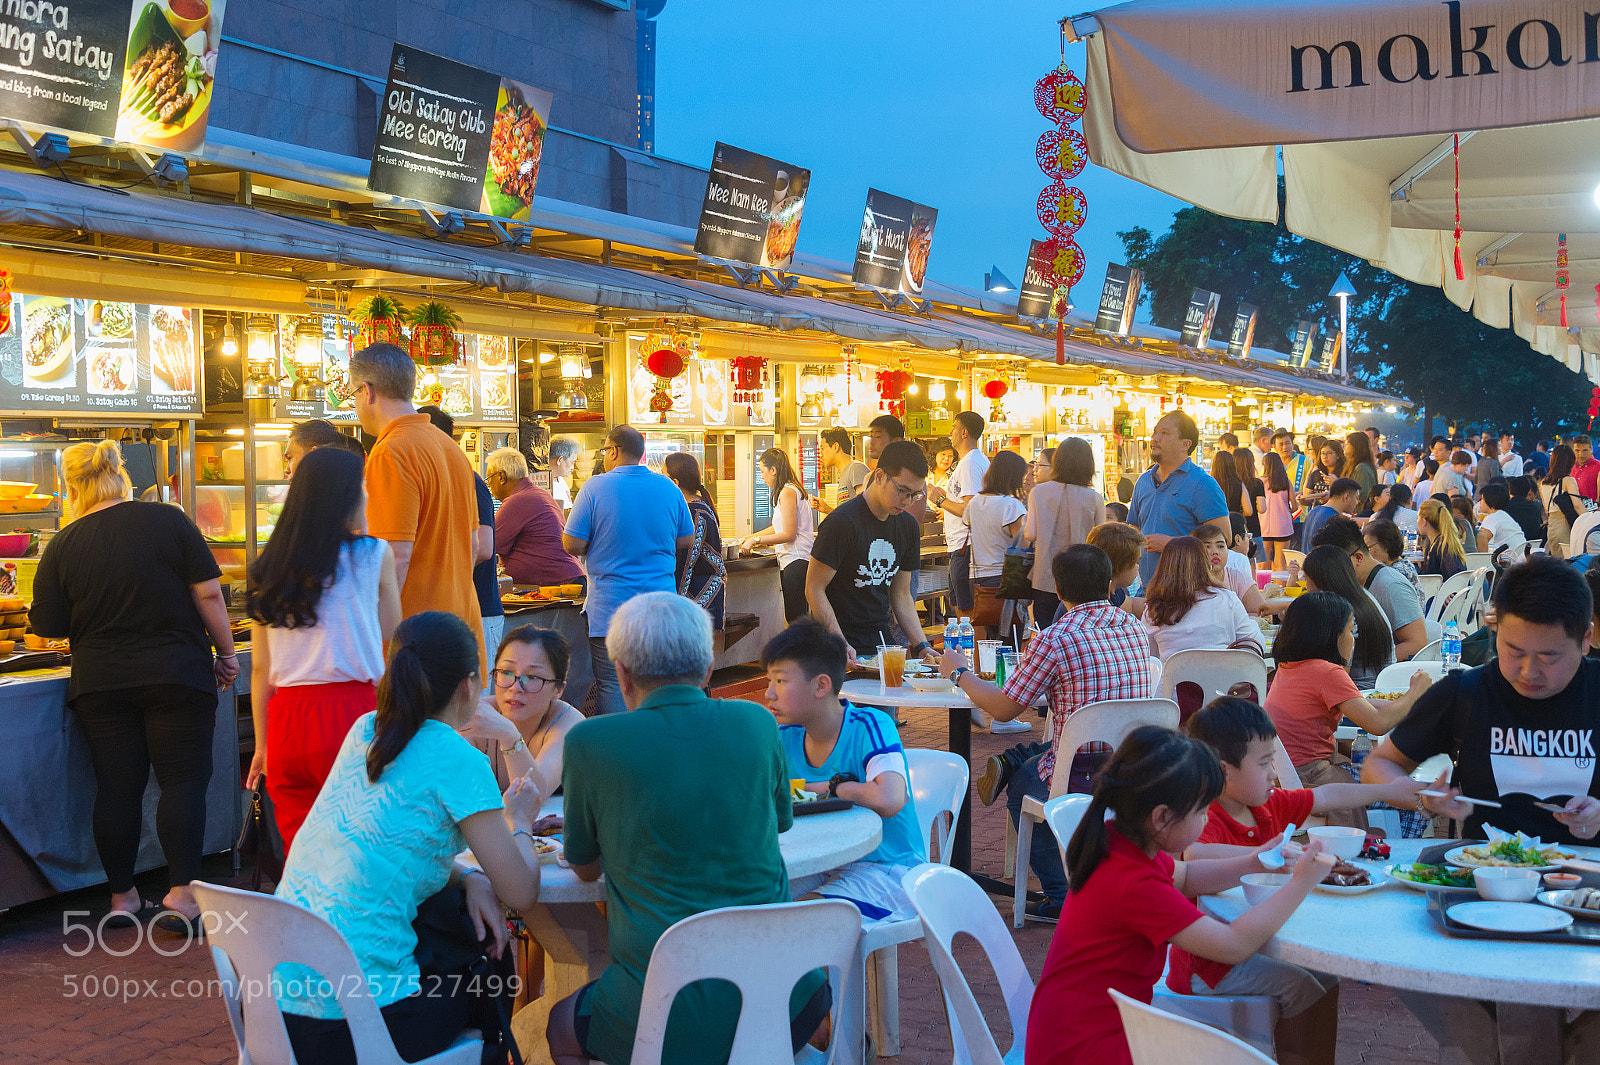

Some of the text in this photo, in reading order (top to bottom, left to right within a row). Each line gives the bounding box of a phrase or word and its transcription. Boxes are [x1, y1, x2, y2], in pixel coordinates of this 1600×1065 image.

[42, 30, 114, 81] Satay
[14, 80, 32, 98] bbq
[33, 84, 54, 100] from
[55, 92, 62, 101] a
[62, 92, 82, 106] local
[82, 96, 108, 112] legend
[388, 90, 486, 134] Old Satay Club
[382, 114, 467, 162] Mee Goreng
[397, 159, 405, 168] of
[708, 182, 769, 213] Wee Nam Kee
[884, 228, 906, 252] Huat
[1490, 727, 1597, 757] BANGKOK
